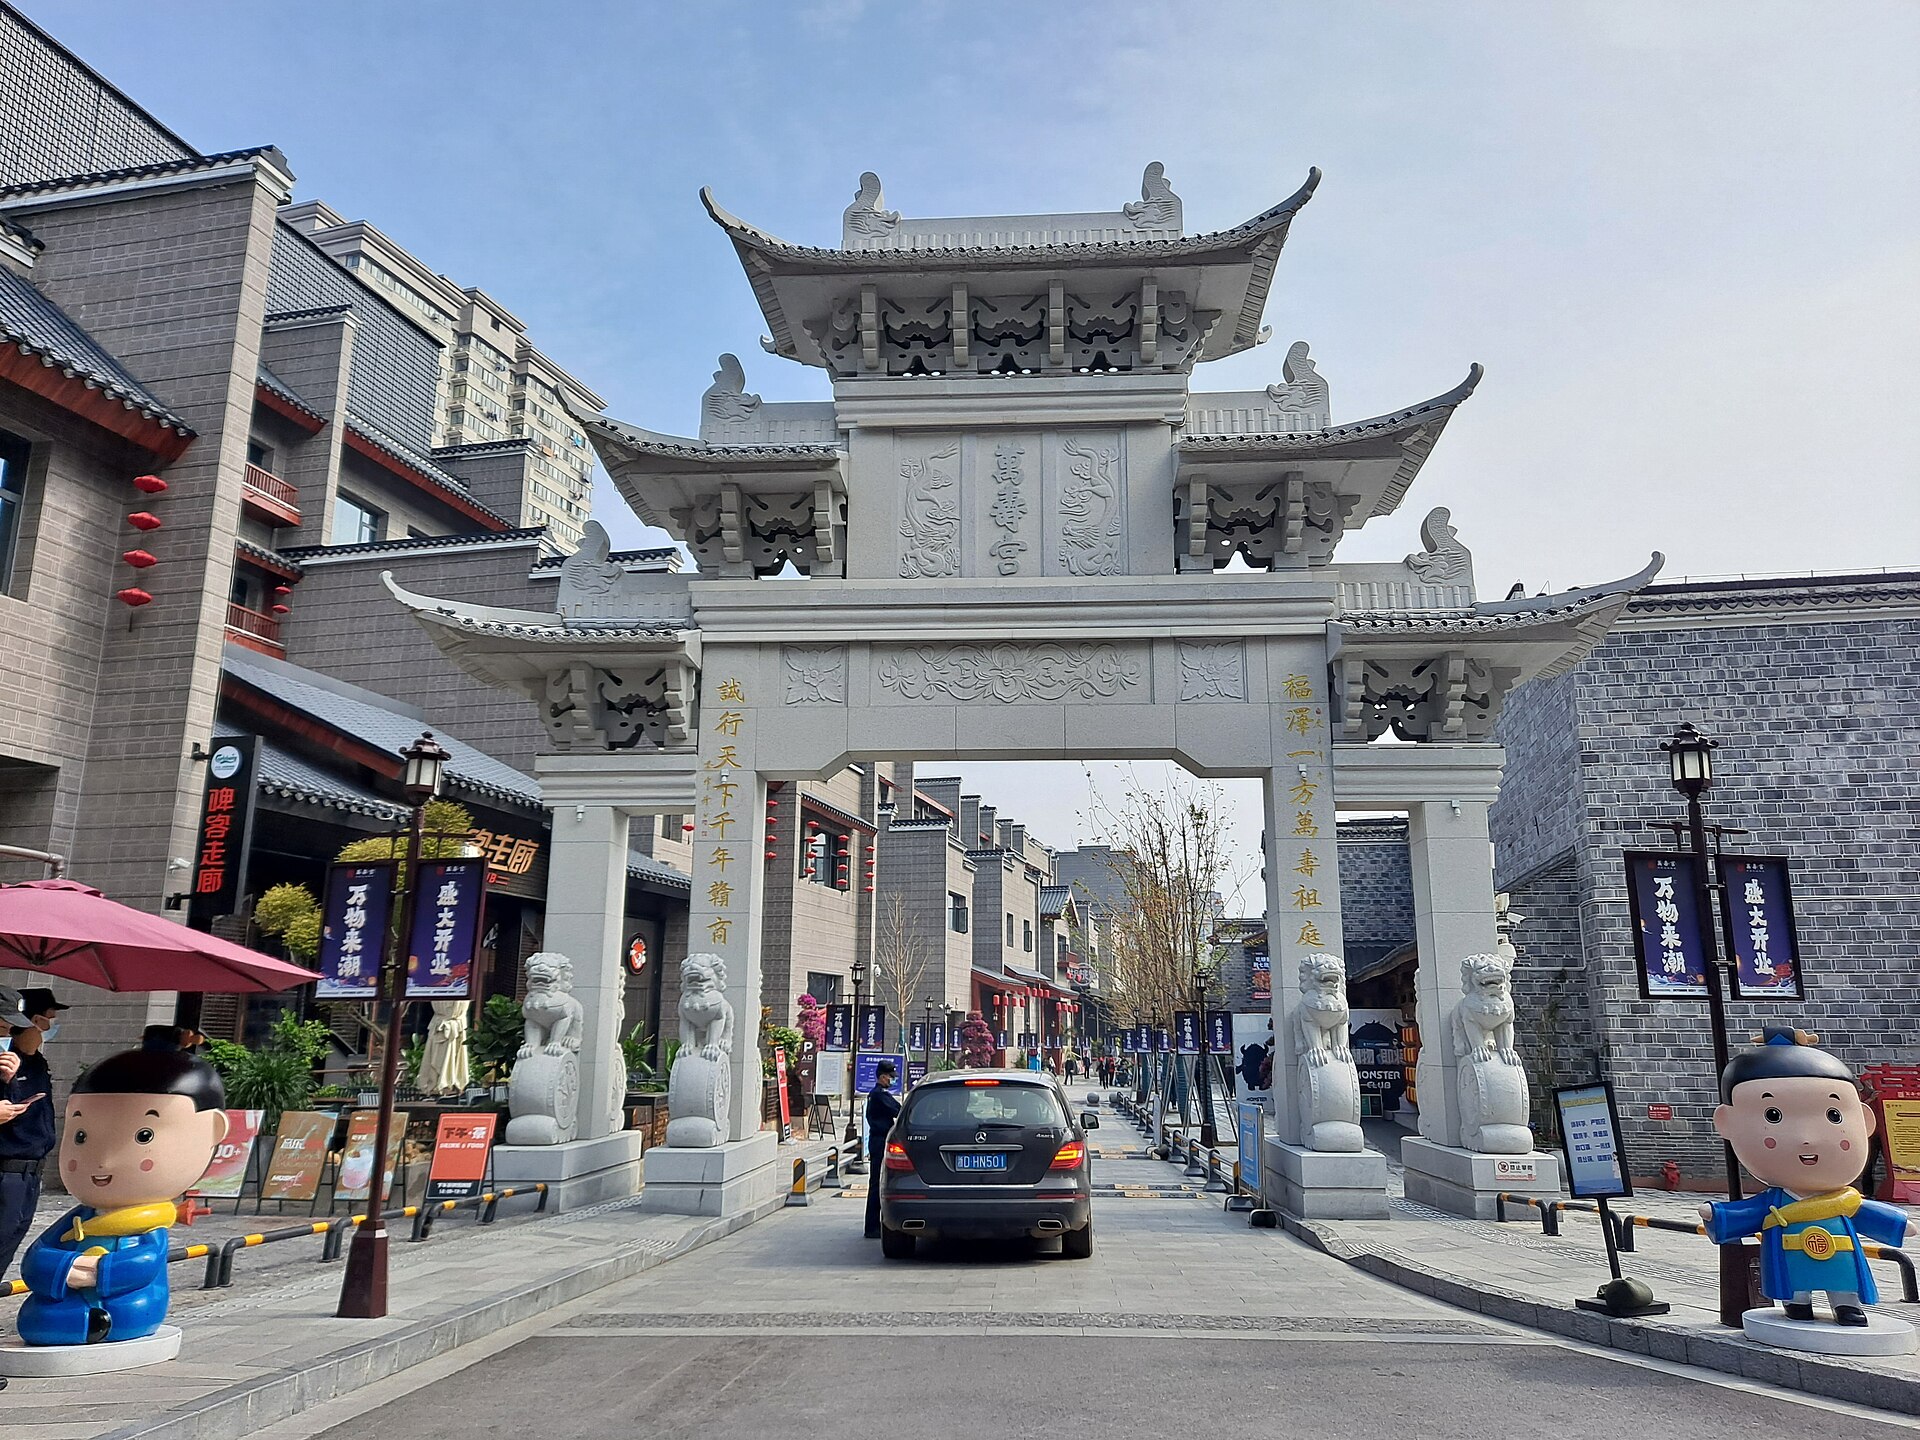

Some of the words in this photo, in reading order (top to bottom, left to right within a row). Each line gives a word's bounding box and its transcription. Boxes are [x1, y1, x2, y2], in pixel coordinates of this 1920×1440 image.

[196, 786, 235, 894] 啤客走廊
[337, 884, 369, 977] 万物来潮
[430, 881, 459, 976] 盛大开业
[1653, 876, 1686, 974] 万物来潮
[1744, 878, 1778, 977] 盛大开业
[804, 1042, 813, 1052] P
[1367, 1081, 1392, 1089] CLUB
